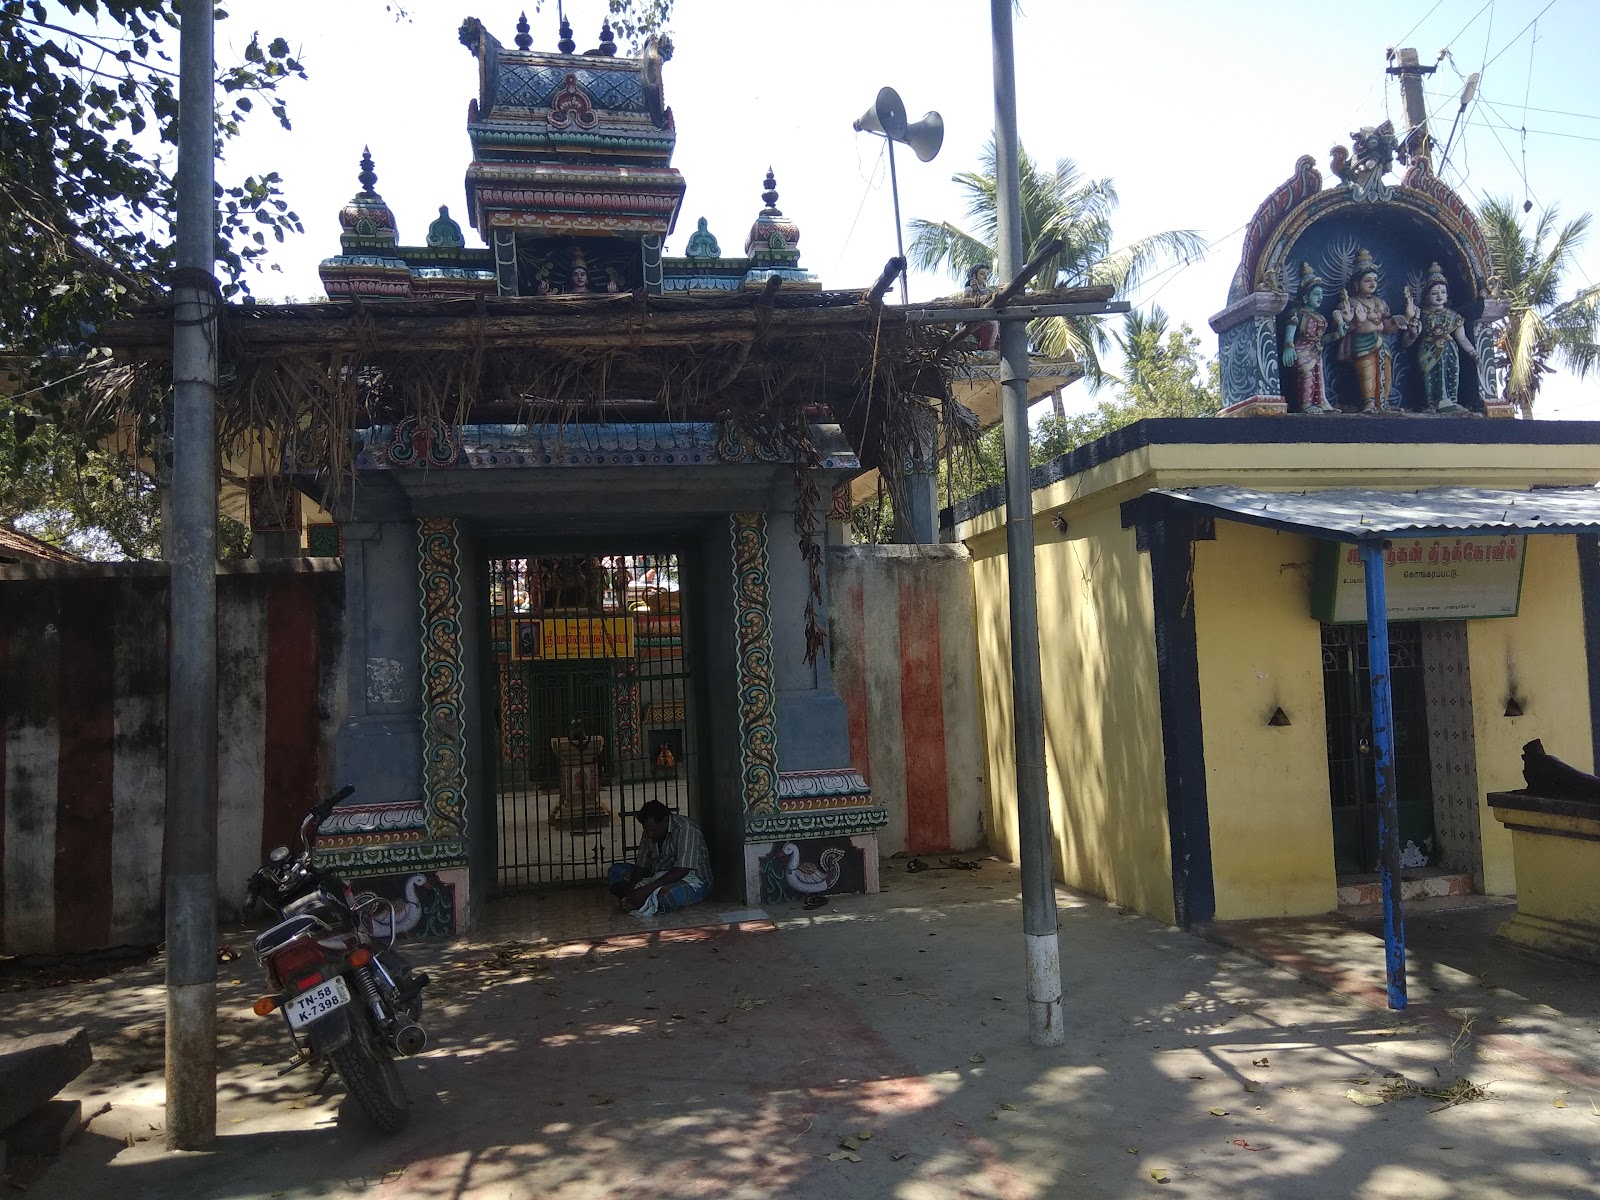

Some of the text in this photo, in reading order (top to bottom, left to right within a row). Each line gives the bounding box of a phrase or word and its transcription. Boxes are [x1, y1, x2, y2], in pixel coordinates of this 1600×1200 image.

[1427, 537, 1517, 566] திருக்கோவில்
[297, 986, 332, 1009] TN-58
[298, 995, 339, 1022] K-7398
